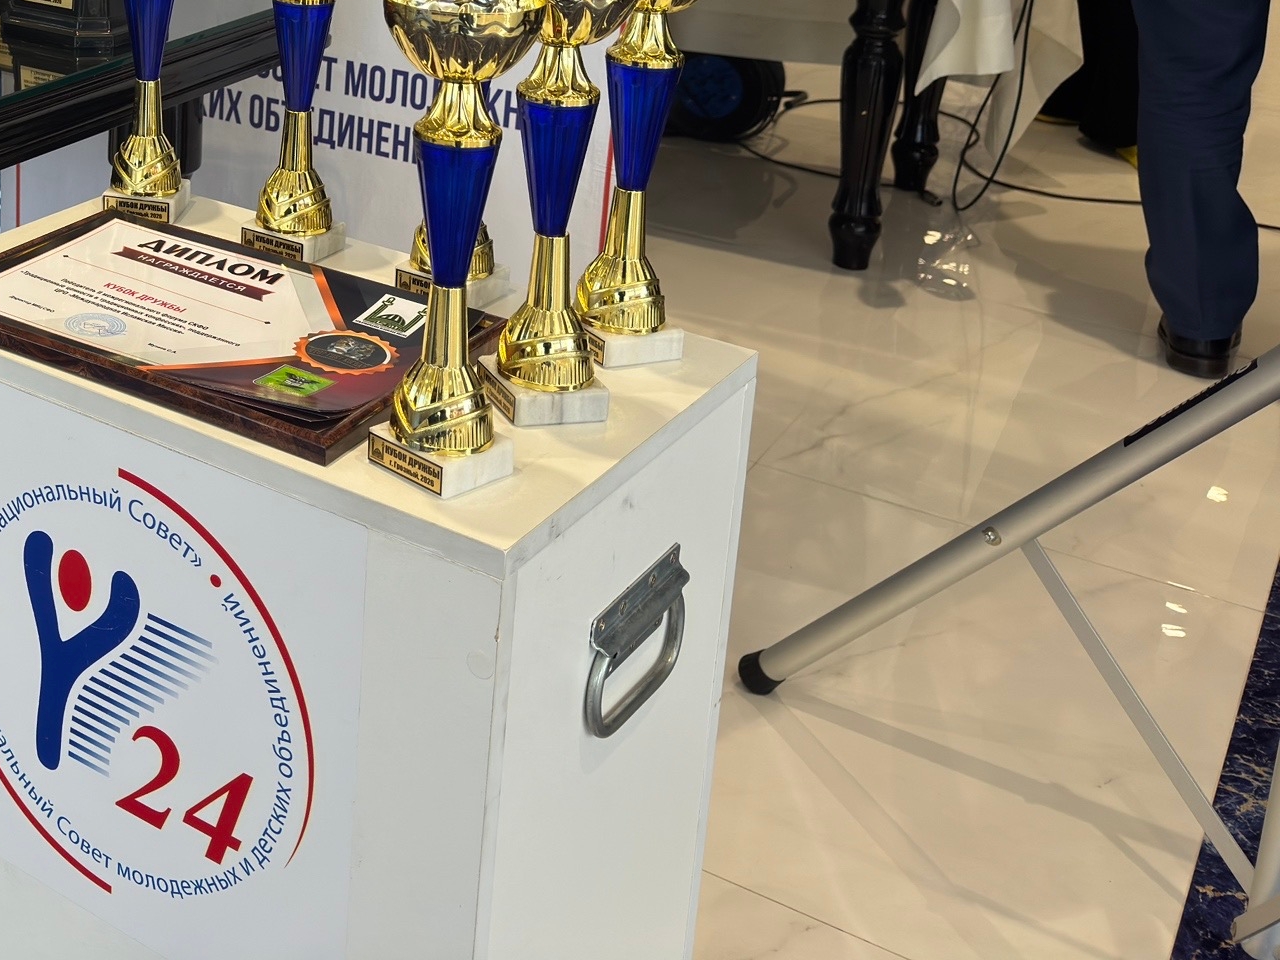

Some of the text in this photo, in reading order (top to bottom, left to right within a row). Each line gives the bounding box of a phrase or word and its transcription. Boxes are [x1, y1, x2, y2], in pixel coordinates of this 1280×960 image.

[138, 203, 167, 213] ДРУЖБЫ
[137, 239, 286, 286] ДИПЛОМ
[274, 240, 301, 254] ДРУЖБЫ
[137, 254, 247, 293] НАГРАЖДАЕТСЯ
[103, 282, 187, 314] КУБОК ДРУЖБЫ
[385, 444, 440, 480] КУБОК ДРУЖБЫ
[127, 499, 204, 569] Совет»
[221, 591, 295, 780] объединений
[115, 725, 255, 865] 24
[55, 815, 114, 866] Совет
[250, 784, 294, 871] детских
[116, 861, 241, 900] молодежных
